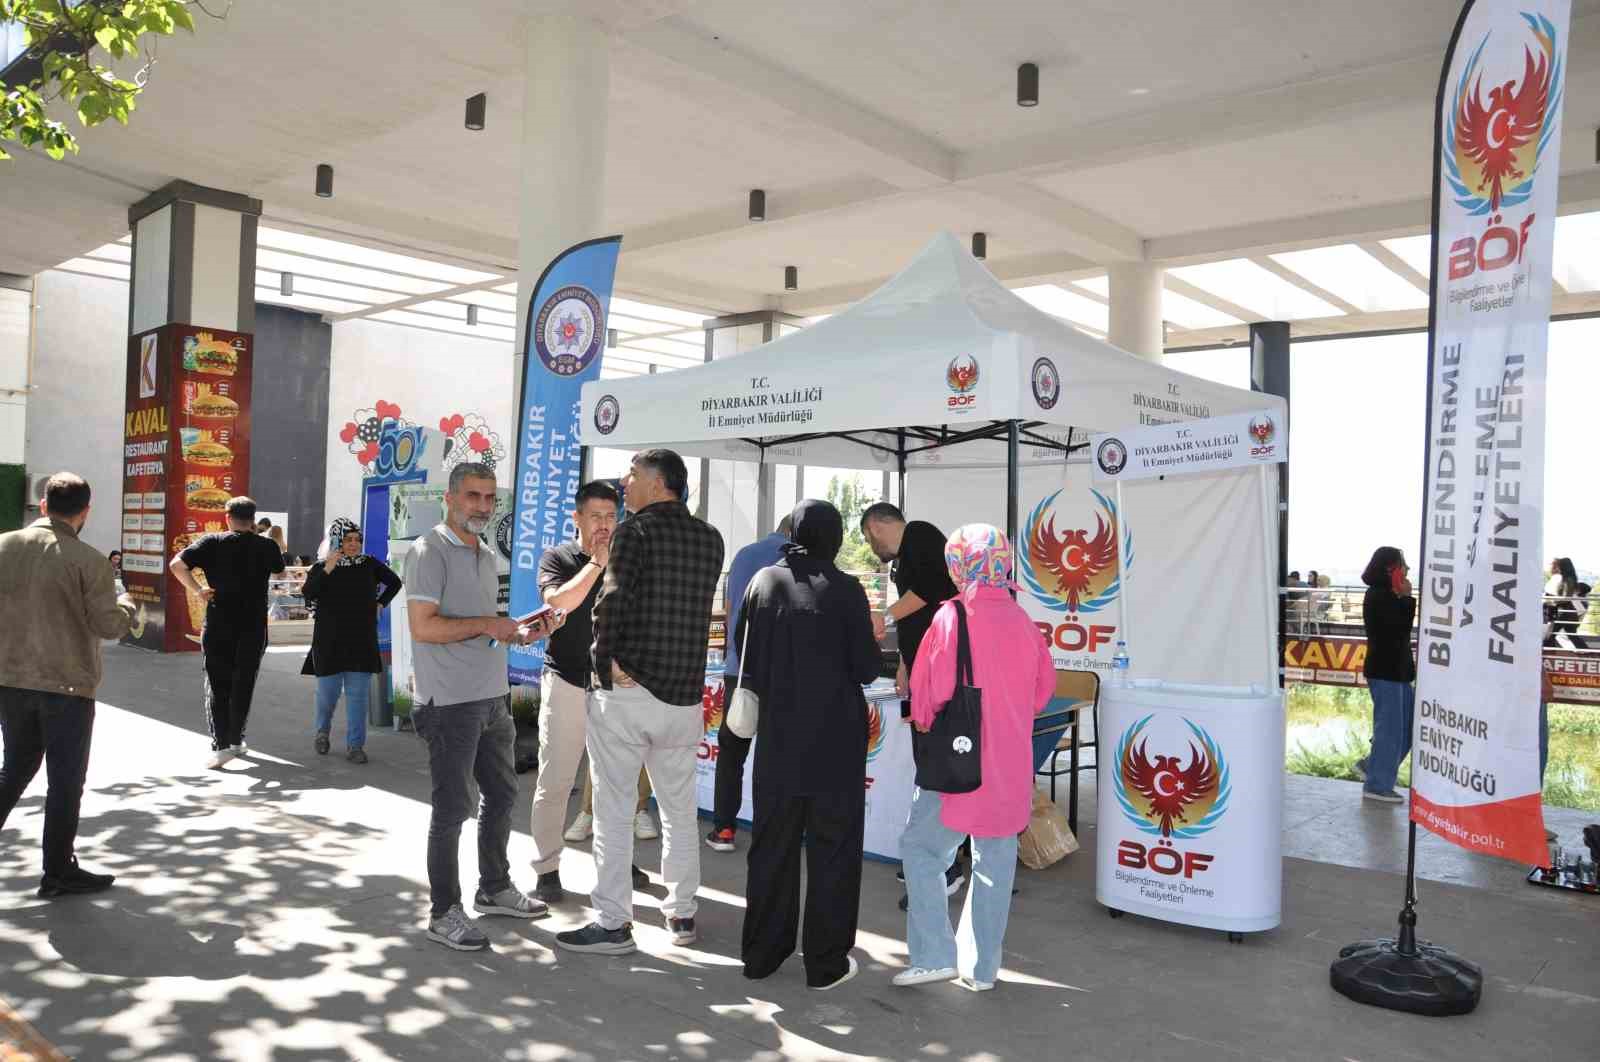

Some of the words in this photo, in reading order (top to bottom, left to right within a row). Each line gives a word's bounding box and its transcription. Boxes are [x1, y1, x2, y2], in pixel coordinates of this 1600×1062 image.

[751, 376, 770, 389] T.C.
[701, 394, 768, 411] DİYARBAKIR
[771, 386, 823, 404] VALİLİĞİ
[947, 393, 976, 406] BÖF
[125, 406, 169, 437] KAVAL
[718, 413, 755, 428] Emniyet
[757, 408, 813, 424] Müdürlüğü
[1135, 442, 1193, 457] DİYARBAKIR
[1195, 434, 1239, 451] VALİLİĞİ
[1175, 429, 1193, 439] T.C.
[124, 440, 169, 458] RESTAURANT
[1150, 454, 1185, 468] Emniyet
[1187, 449, 1233, 463] Müdürlüğü
[516, 404, 546, 569] DİYARBAKIR
[542, 428, 566, 552] EMNİYET
[1424, 343, 1462, 667] BİLGİLENDİRME
[1284, 639, 1368, 670] KAVA
[697, 738, 720, 761] ÖF
[1117, 839, 1215, 879] BÖF
[1115, 870, 1165, 889] Bilgilendirme
[1167, 883, 1178, 892] ve
[1179, 880, 1215, 898] Önleme
[1140, 886, 1184, 904] Faaliyetleri
